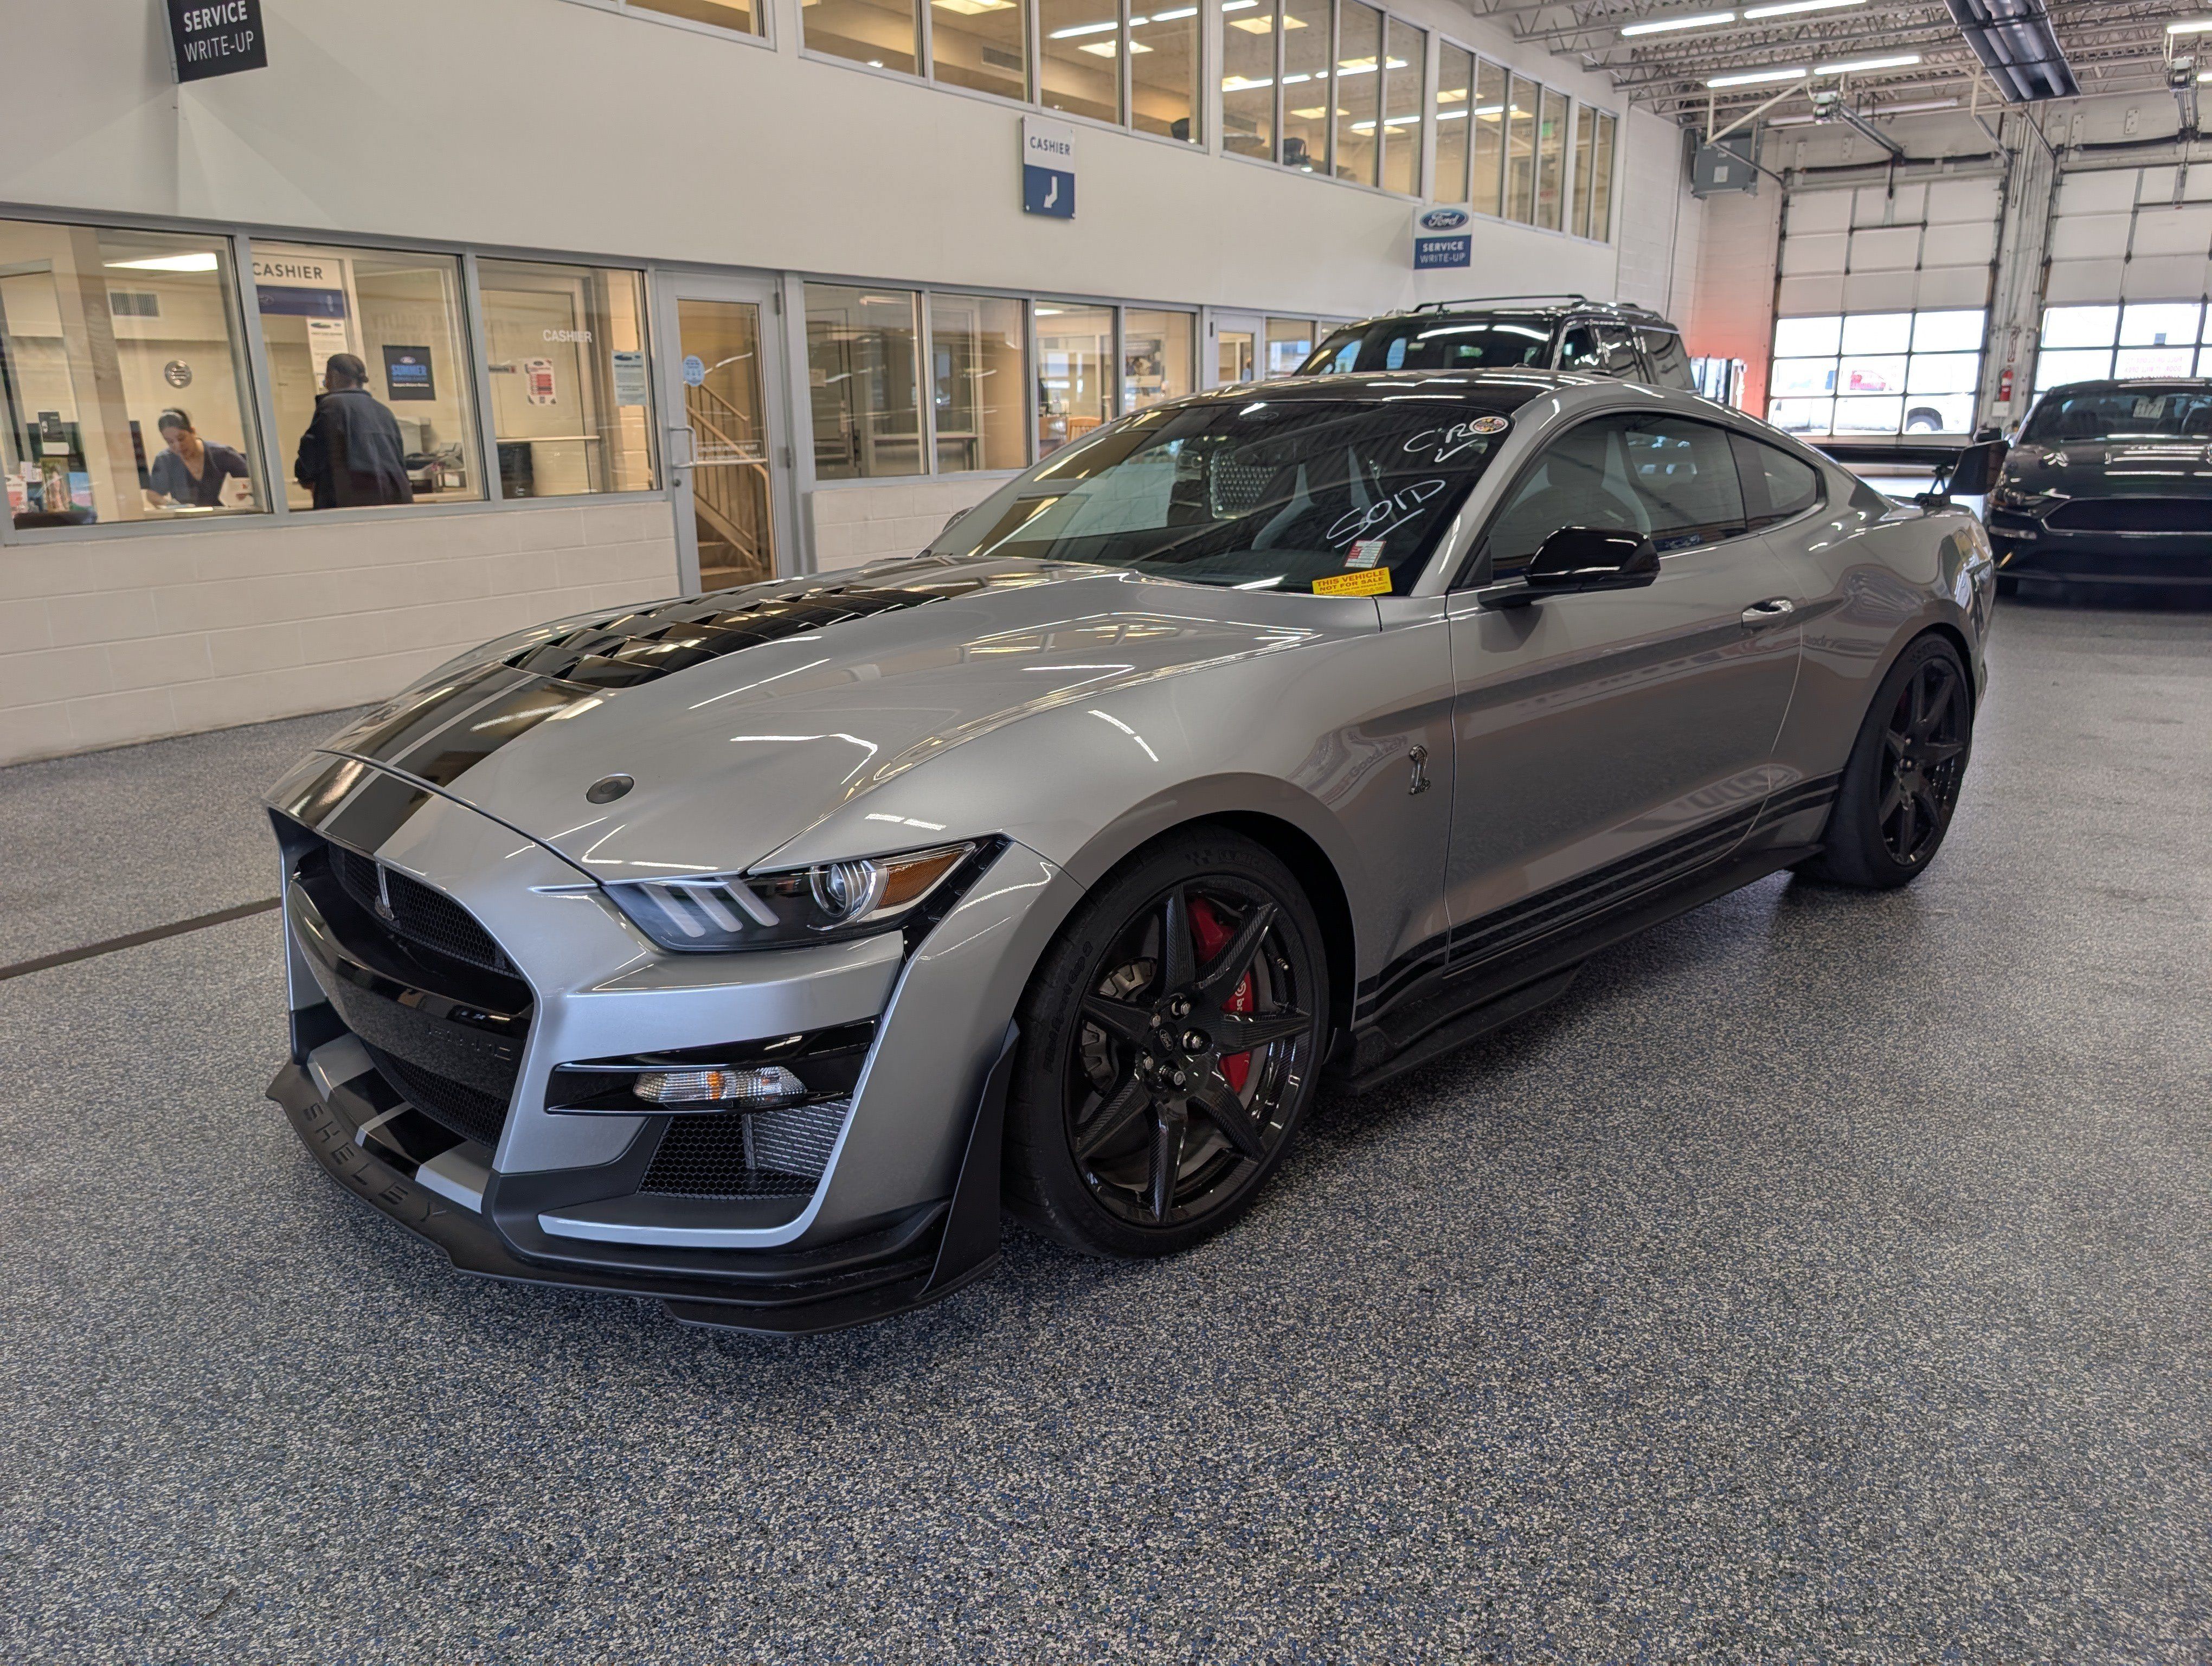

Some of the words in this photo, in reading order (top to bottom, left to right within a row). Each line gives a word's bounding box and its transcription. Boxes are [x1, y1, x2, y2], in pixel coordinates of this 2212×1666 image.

[183, 1, 248, 33] SERVICE
[183, 30, 254, 62] WRITE-UP
[1030, 136, 1071, 156] CASHIER
[1427, 212, 1461, 227] Ford
[1423, 241, 1464, 252] SERVICE
[1420, 253, 1466, 263] WRITE-UP
[253, 262, 324, 280] CASHIER
[543, 329, 593, 343] CASHIER
[1316, 578, 1339, 587] THIS
[1342, 570, 1386, 582] VEHICLE
[1361, 576, 1384, 585] SALE
